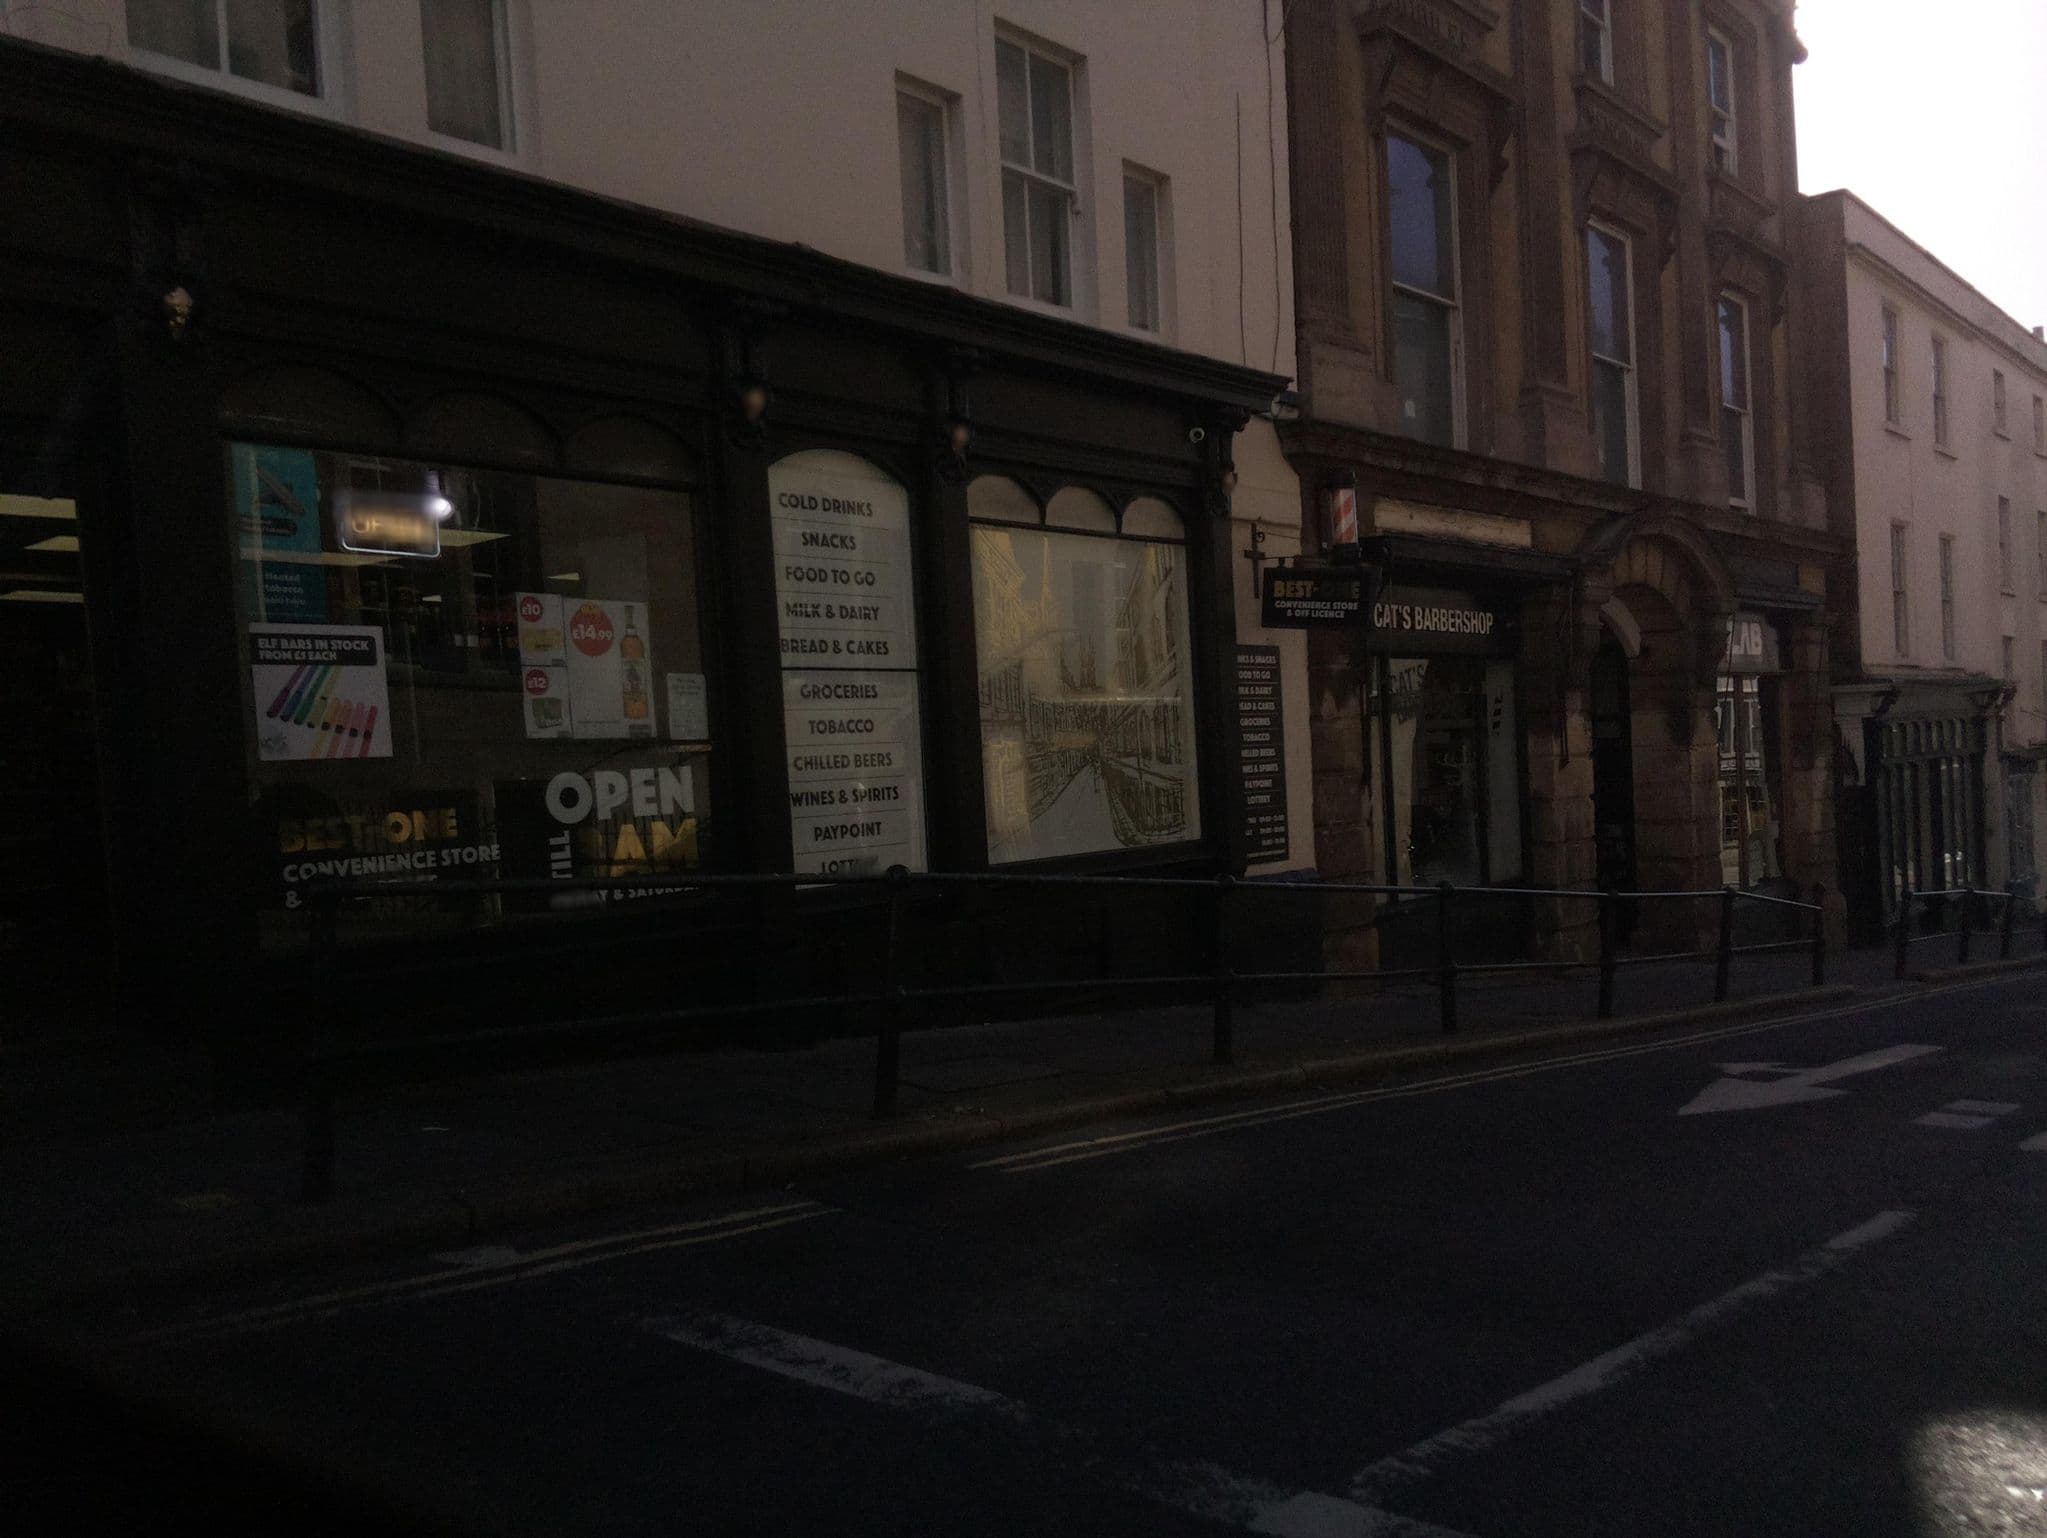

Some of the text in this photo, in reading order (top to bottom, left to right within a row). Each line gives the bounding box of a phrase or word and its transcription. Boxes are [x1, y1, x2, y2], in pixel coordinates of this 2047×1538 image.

[778, 493, 873, 517] COLD DRINKS
[801, 531, 857, 550] SNACKS
[785, 566, 876, 586] FOOD TO GO
[786, 603, 879, 621] MILK & DAIRY
[1275, 600, 1359, 611] CONVENIENCE STORE
[1295, 610, 1310, 618] OFF
[1311, 611, 1346, 619] LICENCE
[1373, 602, 1494, 635] CAT'S BARBERSHOP
[572, 623, 613, 641] £14.99
[280, 638, 312, 650] BARS
[315, 639, 328, 650] IN
[330, 640, 370, 652] STOCK
[779, 638, 889, 656] BREAD & CAKES
[259, 650, 294, 661] FROM
[308, 650, 337, 661] EACH
[800, 684, 878, 699] GROCERIES
[809, 719, 874, 734] TOBACCO
[794, 752, 892, 771] CHILLED BEERS
[545, 765, 694, 824] OPEN
[790, 786, 899, 806] WINES & SPIRITS
[814, 821, 881, 841] PAYPOINT
[282, 844, 501, 882] CONVENIENCE STORE
[285, 890, 302, 909] &
